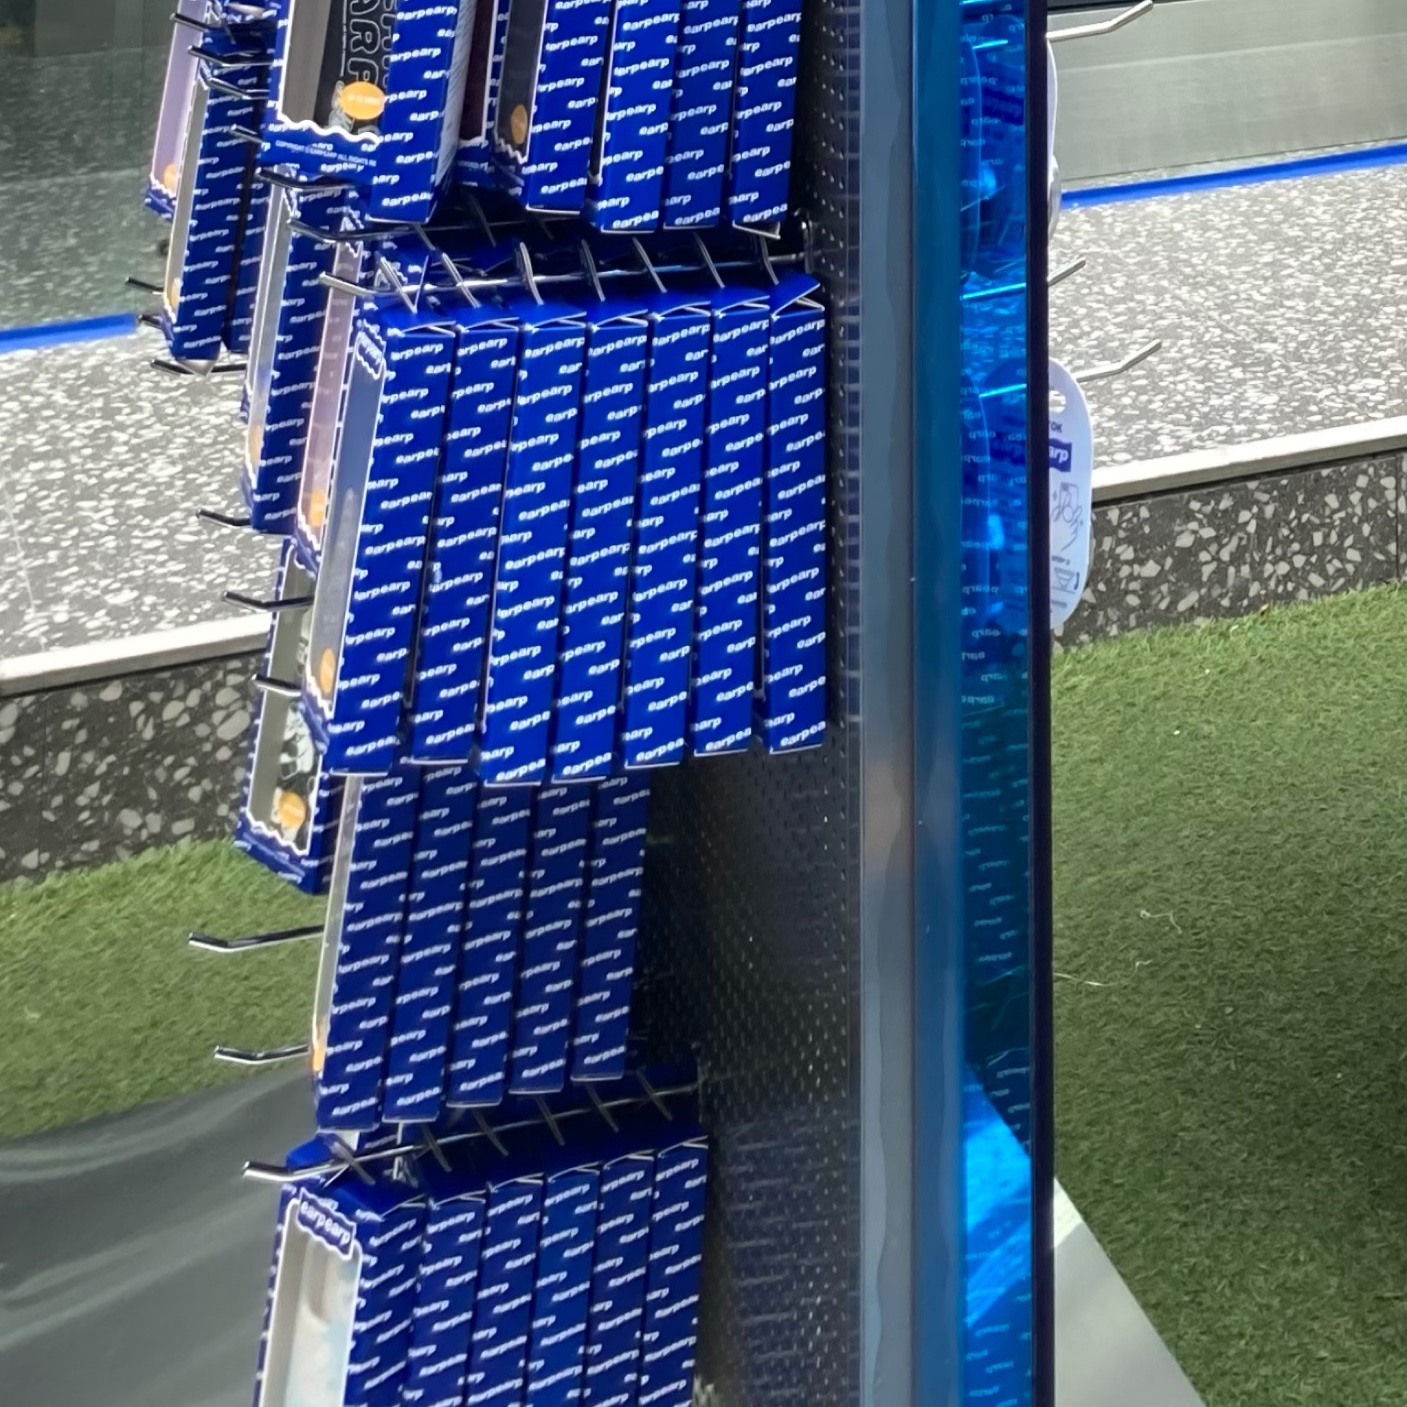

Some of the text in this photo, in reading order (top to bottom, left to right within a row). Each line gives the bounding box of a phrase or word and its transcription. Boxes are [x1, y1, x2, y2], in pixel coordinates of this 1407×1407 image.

[395, 6, 457, 20] earpearp
[1049, 421, 1063, 433] OK
[365, 536, 426, 555] earpearp
[437, 527, 497, 548] earpearp
[301, 1201, 351, 1246] earpearp
